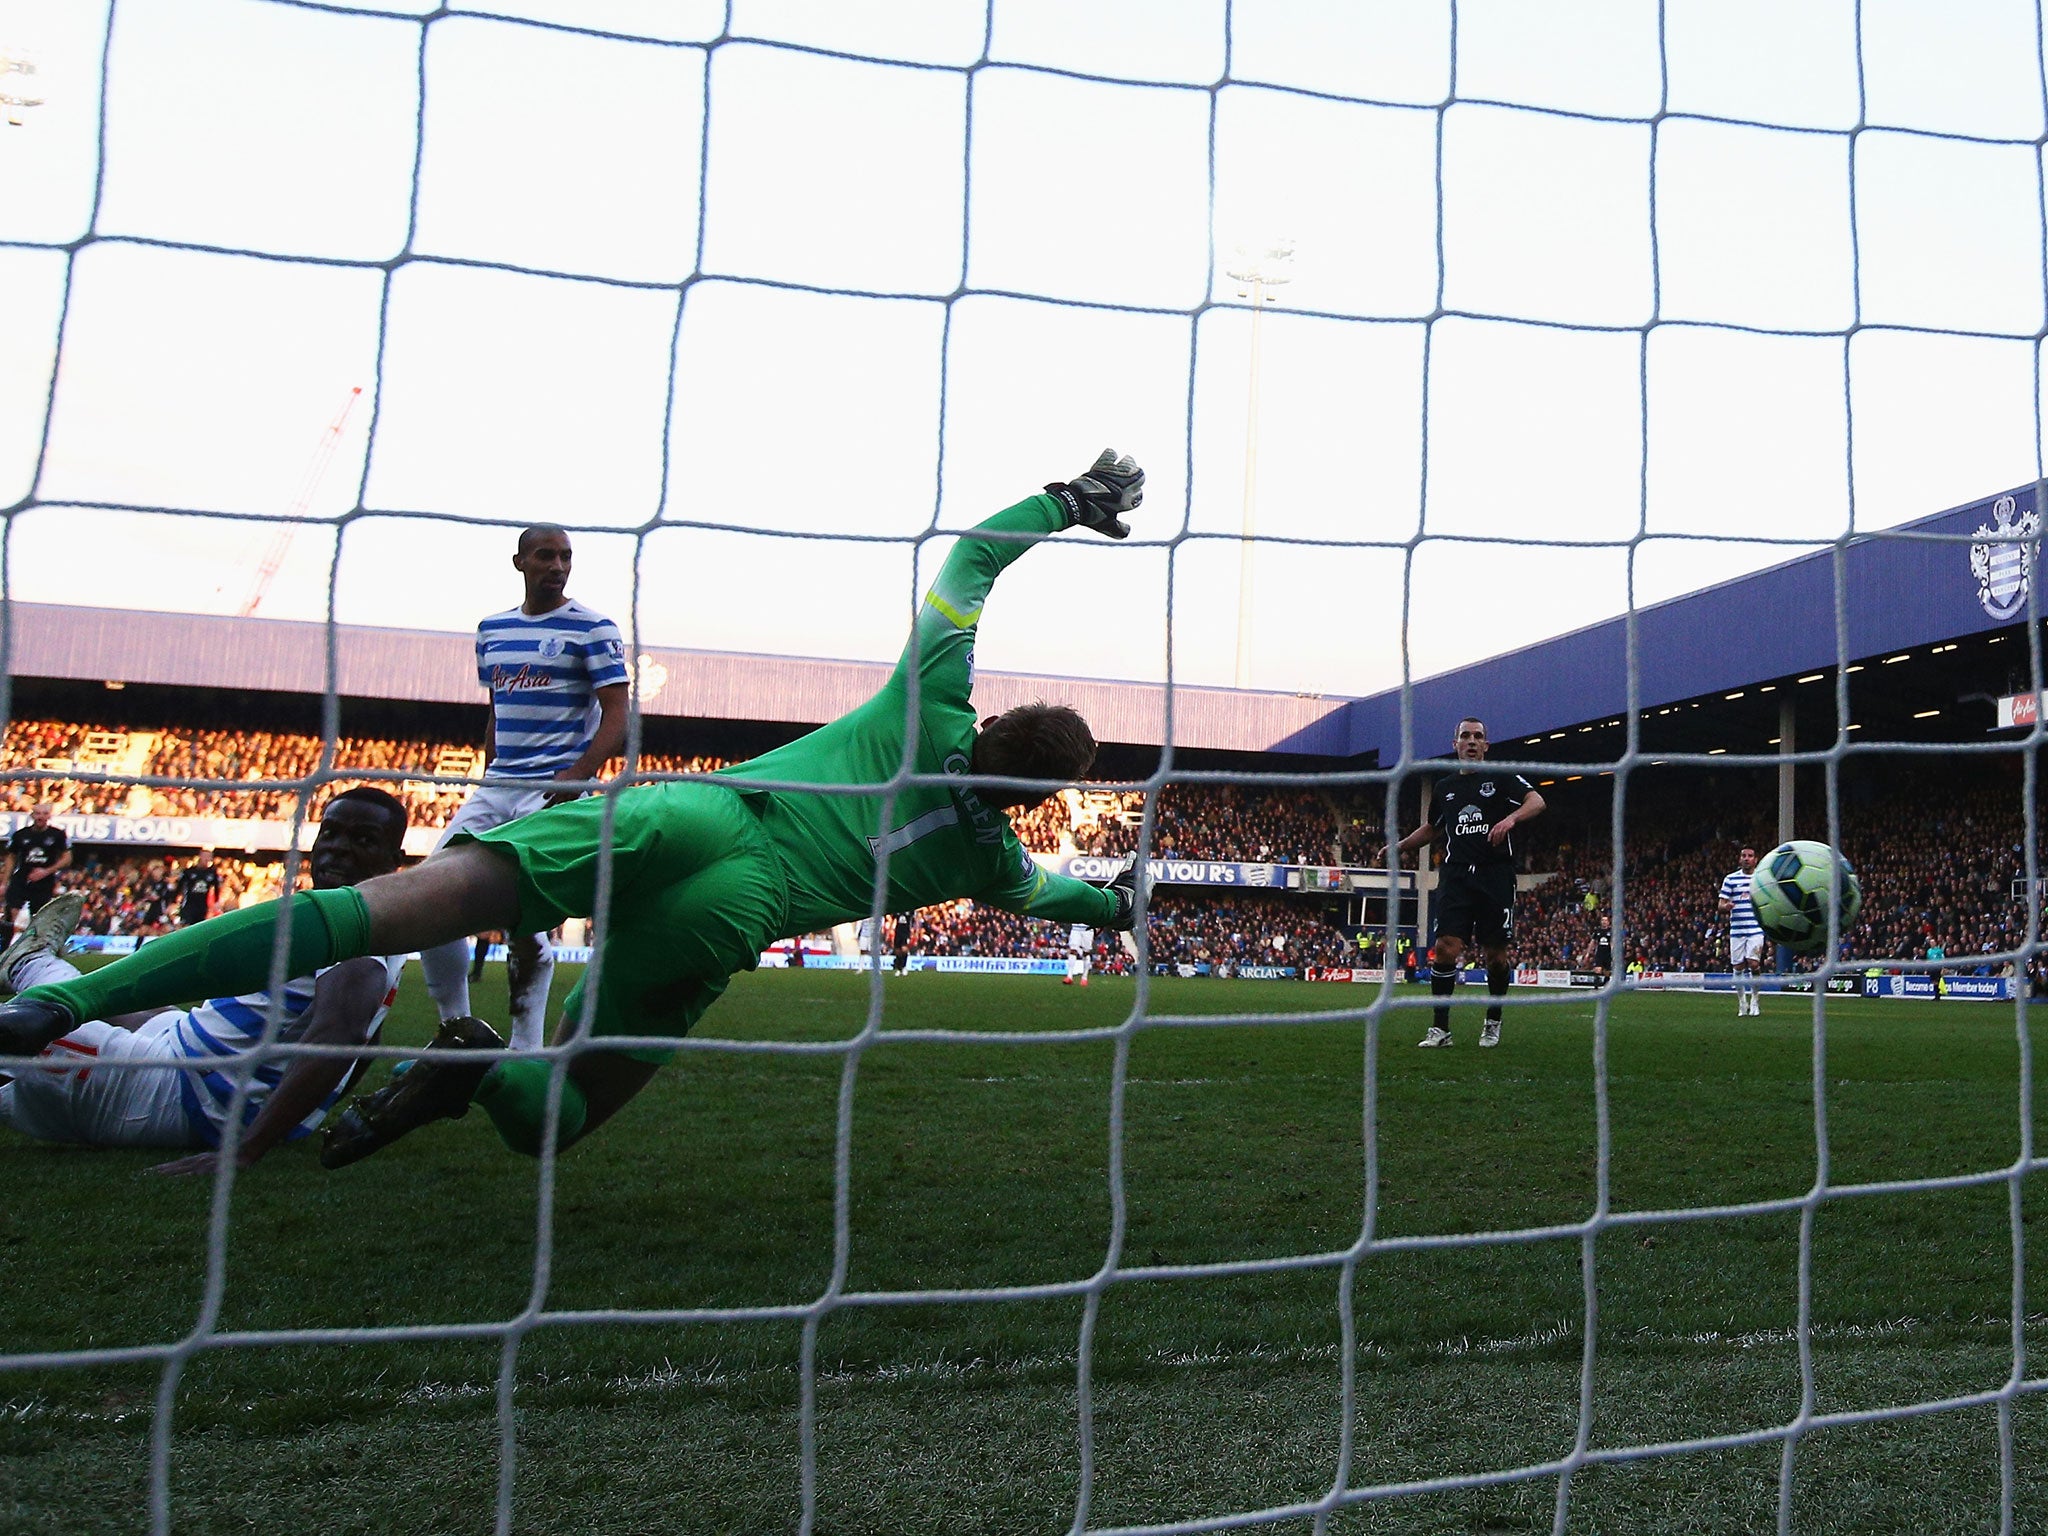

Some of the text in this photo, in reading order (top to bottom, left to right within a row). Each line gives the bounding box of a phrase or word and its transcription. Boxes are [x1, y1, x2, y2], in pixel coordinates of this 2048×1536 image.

[17, 814, 110, 839] LTUS
[115, 818, 191, 842] ROAD
[1455, 823, 1489, 836] Chang
[1166, 862, 1205, 882] YOU
[1209, 864, 1235, 883] R's
[1828, 978, 1853, 992] viagogo
[1866, 979, 1879, 994] P8
[1905, 981, 1928, 992] Become
[1953, 982, 1977, 993] Member
